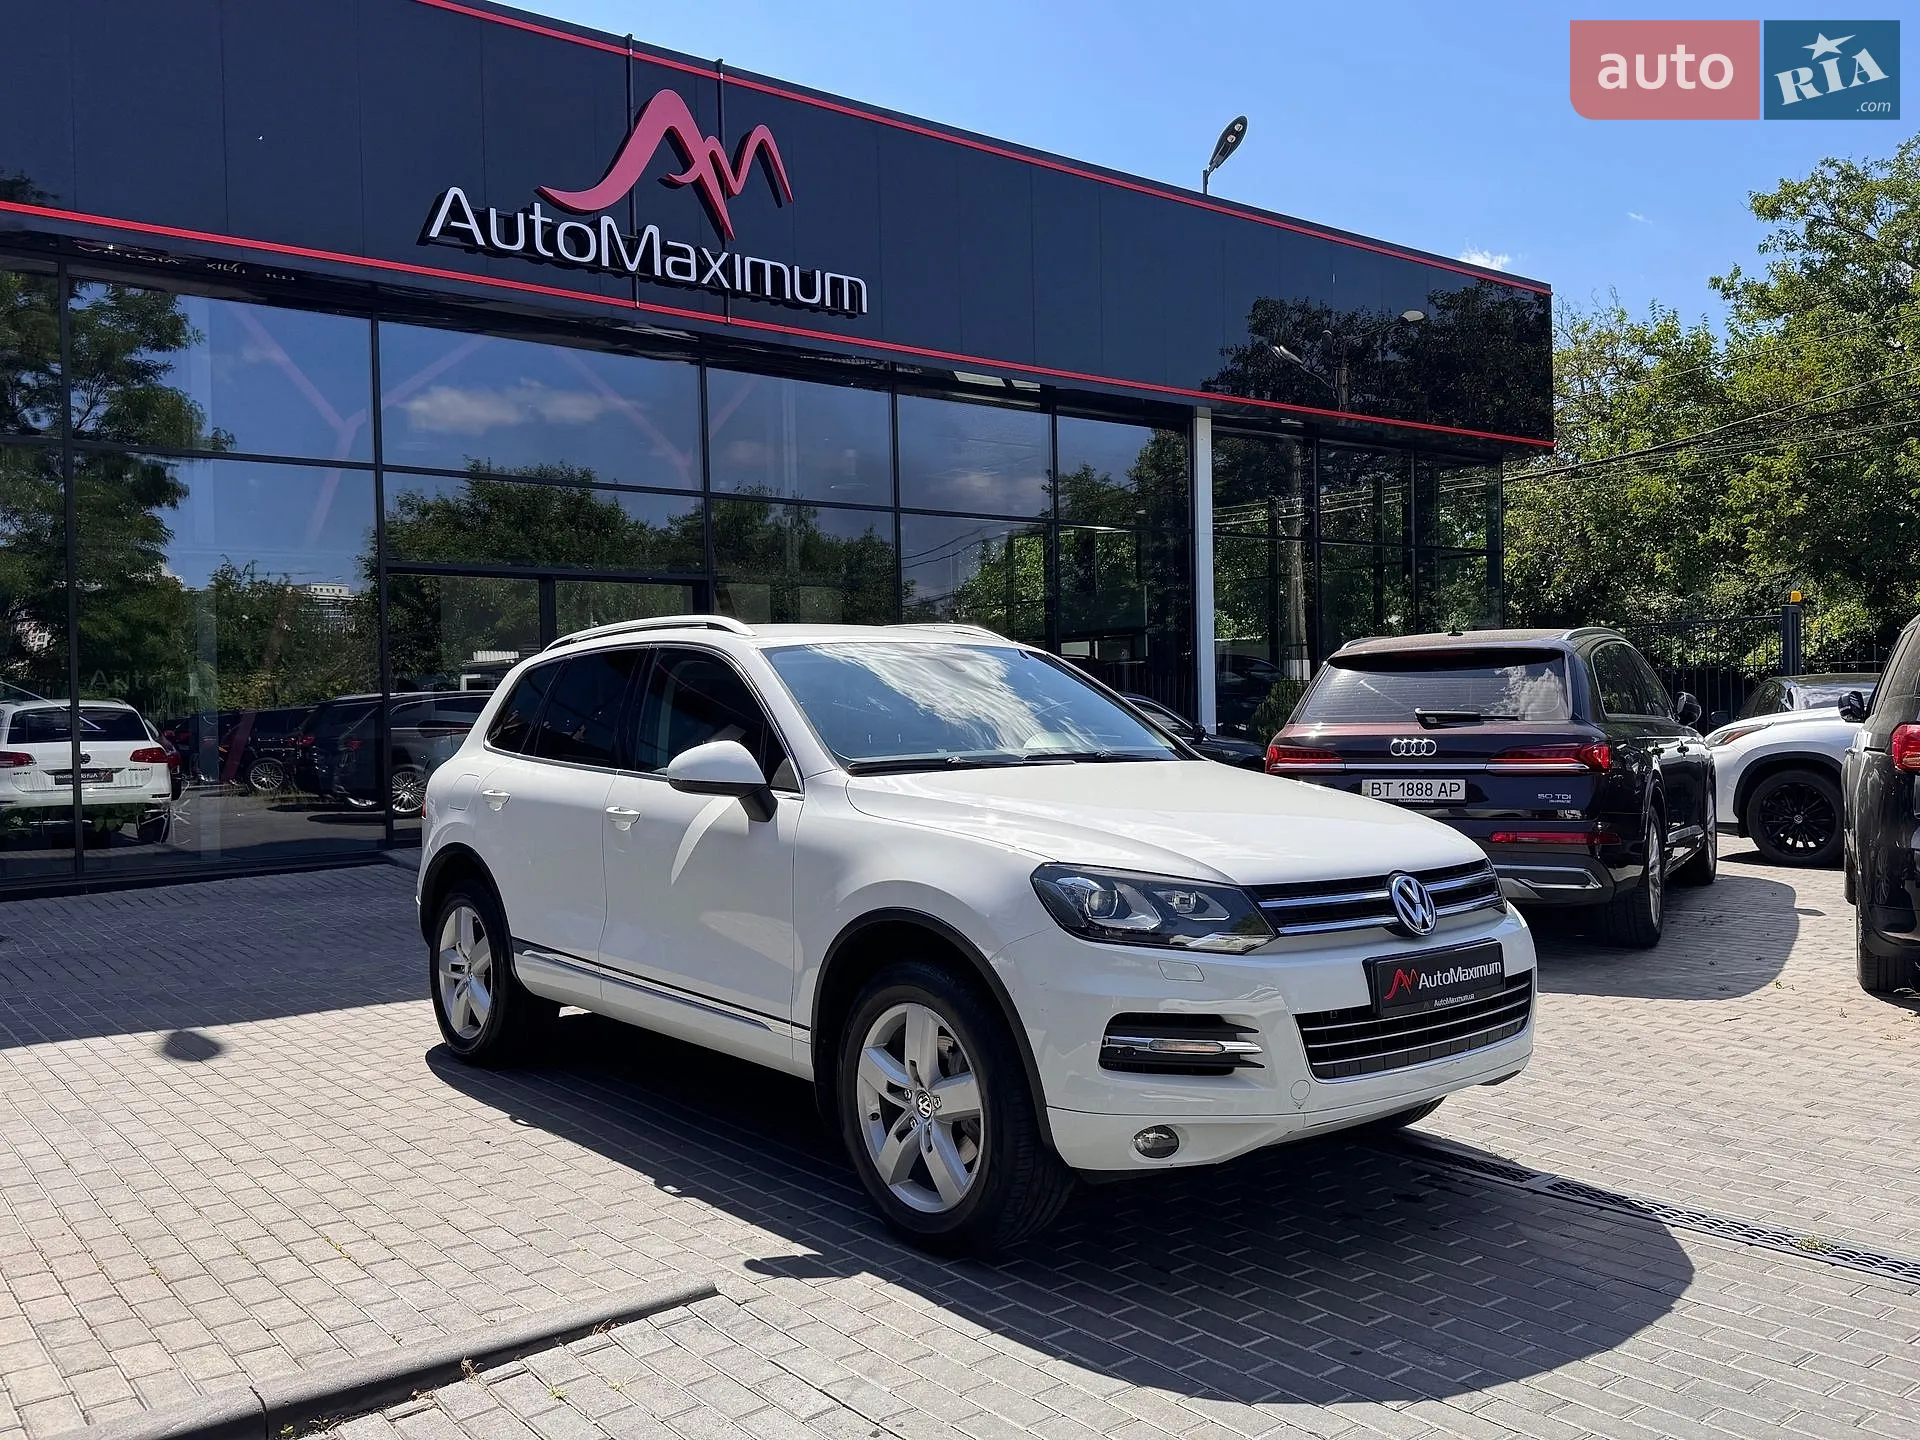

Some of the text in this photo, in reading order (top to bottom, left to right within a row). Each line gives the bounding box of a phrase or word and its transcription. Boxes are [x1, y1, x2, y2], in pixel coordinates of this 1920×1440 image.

[429, 186, 868, 314] AutoMaximum
[1371, 782, 1461, 798] BT 1888 AP
[1418, 961, 1502, 990] AutoMaximum
[1433, 993, 1475, 1008] AutoMaximum.ua
